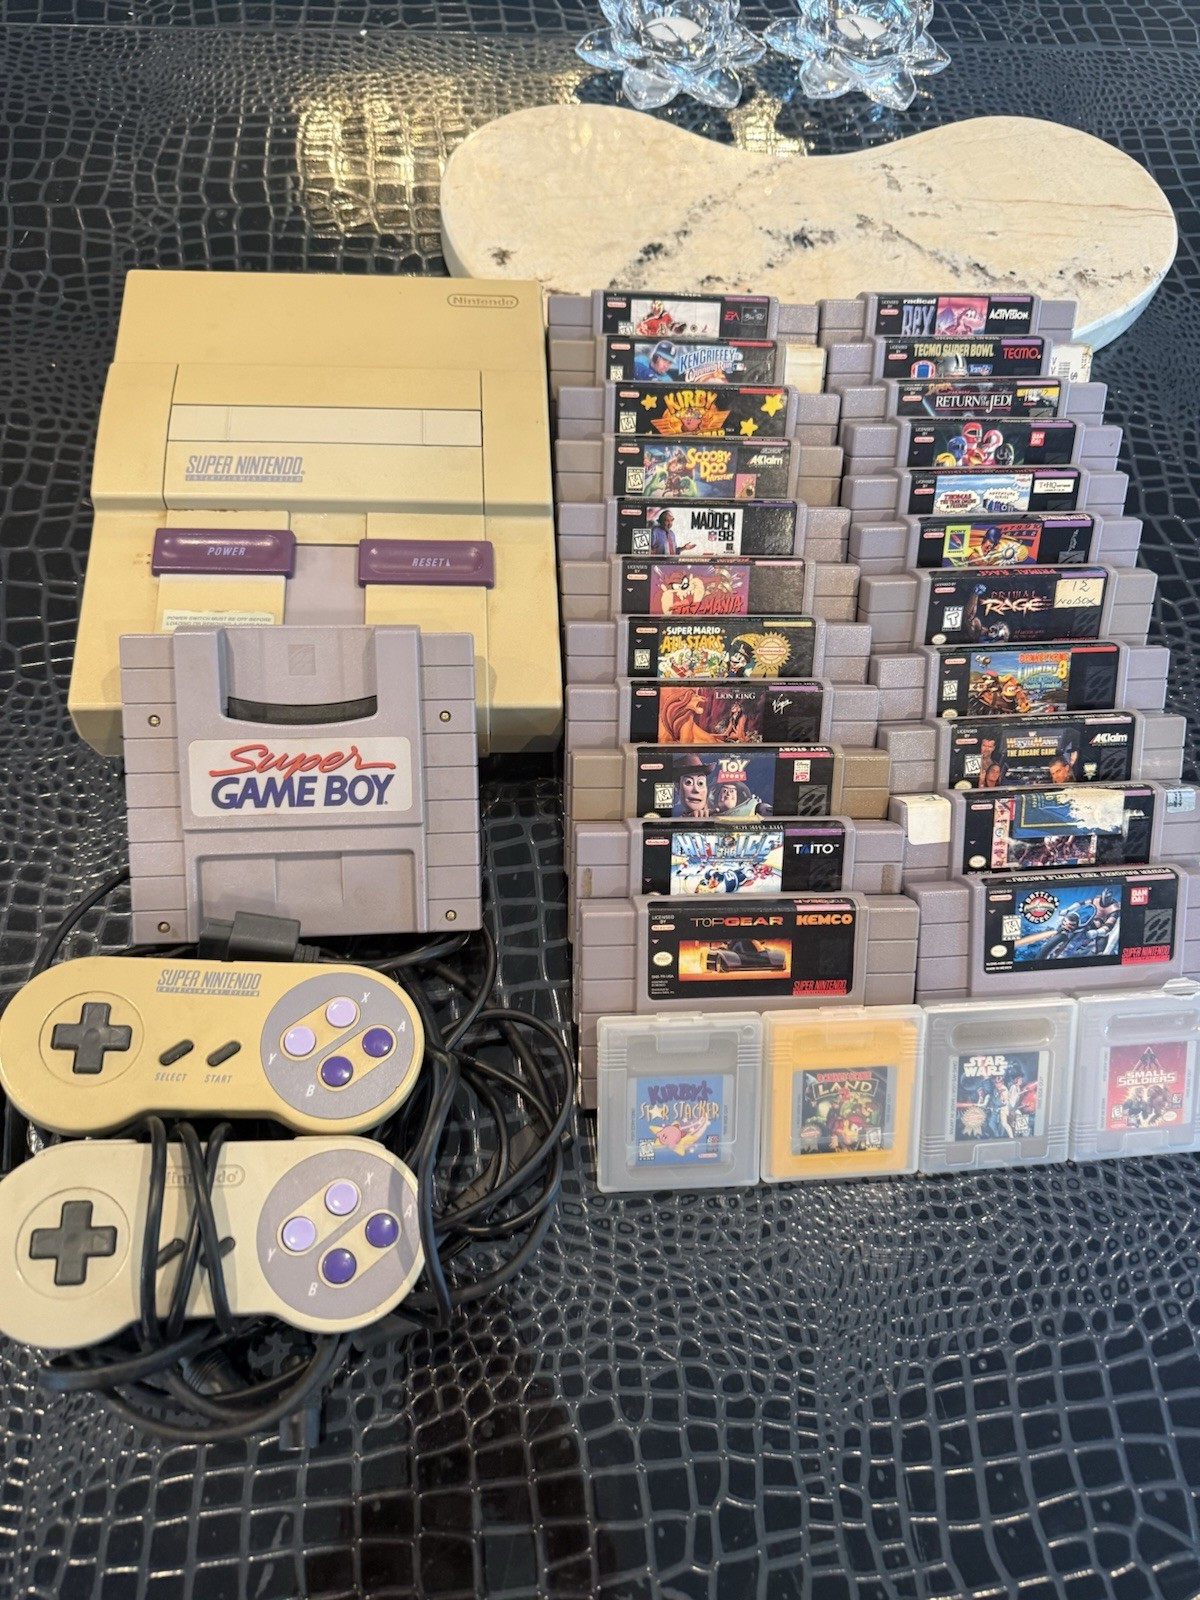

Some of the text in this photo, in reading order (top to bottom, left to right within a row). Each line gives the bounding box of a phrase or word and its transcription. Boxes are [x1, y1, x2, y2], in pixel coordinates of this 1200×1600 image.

[453, 296, 515, 306] Nintendo
[989, 308, 1029, 321] ACTIVISION
[914, 343, 994, 357] TECMO SUPER BOWL
[679, 347, 738, 373] KEN GRIFFEY
[663, 389, 718, 414] KIRBY
[935, 395, 980, 407] RETURN
[985, 395, 1014, 414] JEDI
[186, 455, 304, 476] SUPER NINTENDO
[699, 461, 728, 479] DOO
[690, 511, 735, 530] MADDEN
[718, 531, 735, 542] 98
[207, 547, 247, 557] POWER
[412, 558, 444, 568] RESET
[980, 598, 1048, 617] RAGE
[948, 612, 959, 626] T
[666, 626, 721, 635] SUPER MARIO
[715, 692, 756, 700] LION KING
[1006, 747, 1057, 757] THE ARCADE GAME
[208, 743, 397, 786] Super
[718, 759, 752, 773] TOY
[210, 774, 396, 810] GAME BOY
[677, 833, 718, 857] HIT
[736, 834, 775, 857] ICE
[1046, 873, 1079, 881] BATTLE
[1025, 890, 1054, 904] BATTLE
[1131, 888, 1148, 896] BAN
[1131, 895, 1147, 904] DAI
[796, 913, 853, 926] KEMCO
[1122, 945, 1171, 958] SUPER NINTENDO
[157, 969, 262, 991] SUPER NINTENDO
[793, 979, 847, 991] SUPER NINTENDO
[361, 992, 371, 1004] X
[397, 1021, 407, 1032] A
[268, 1053, 278, 1066] Y
[963, 1055, 1008, 1067] STAR
[154, 1072, 188, 1083] SELECT
[964, 1065, 1008, 1077] WARS
[1127, 1070, 1169, 1079] SMALL
[204, 1074, 234, 1084] START
[1117, 1073, 1178, 1086] SOLDIERS
[306, 1085, 315, 1097] B
[648, 1079, 714, 1106] KIRBY'S
[818, 1080, 873, 1096] LAND
[672, 1099, 721, 1119] STACKER
[364, 1172, 375, 1186] X
[403, 1205, 414, 1219] A
[266, 1248, 278, 1263] Y
[308, 1283, 319, 1297] B
